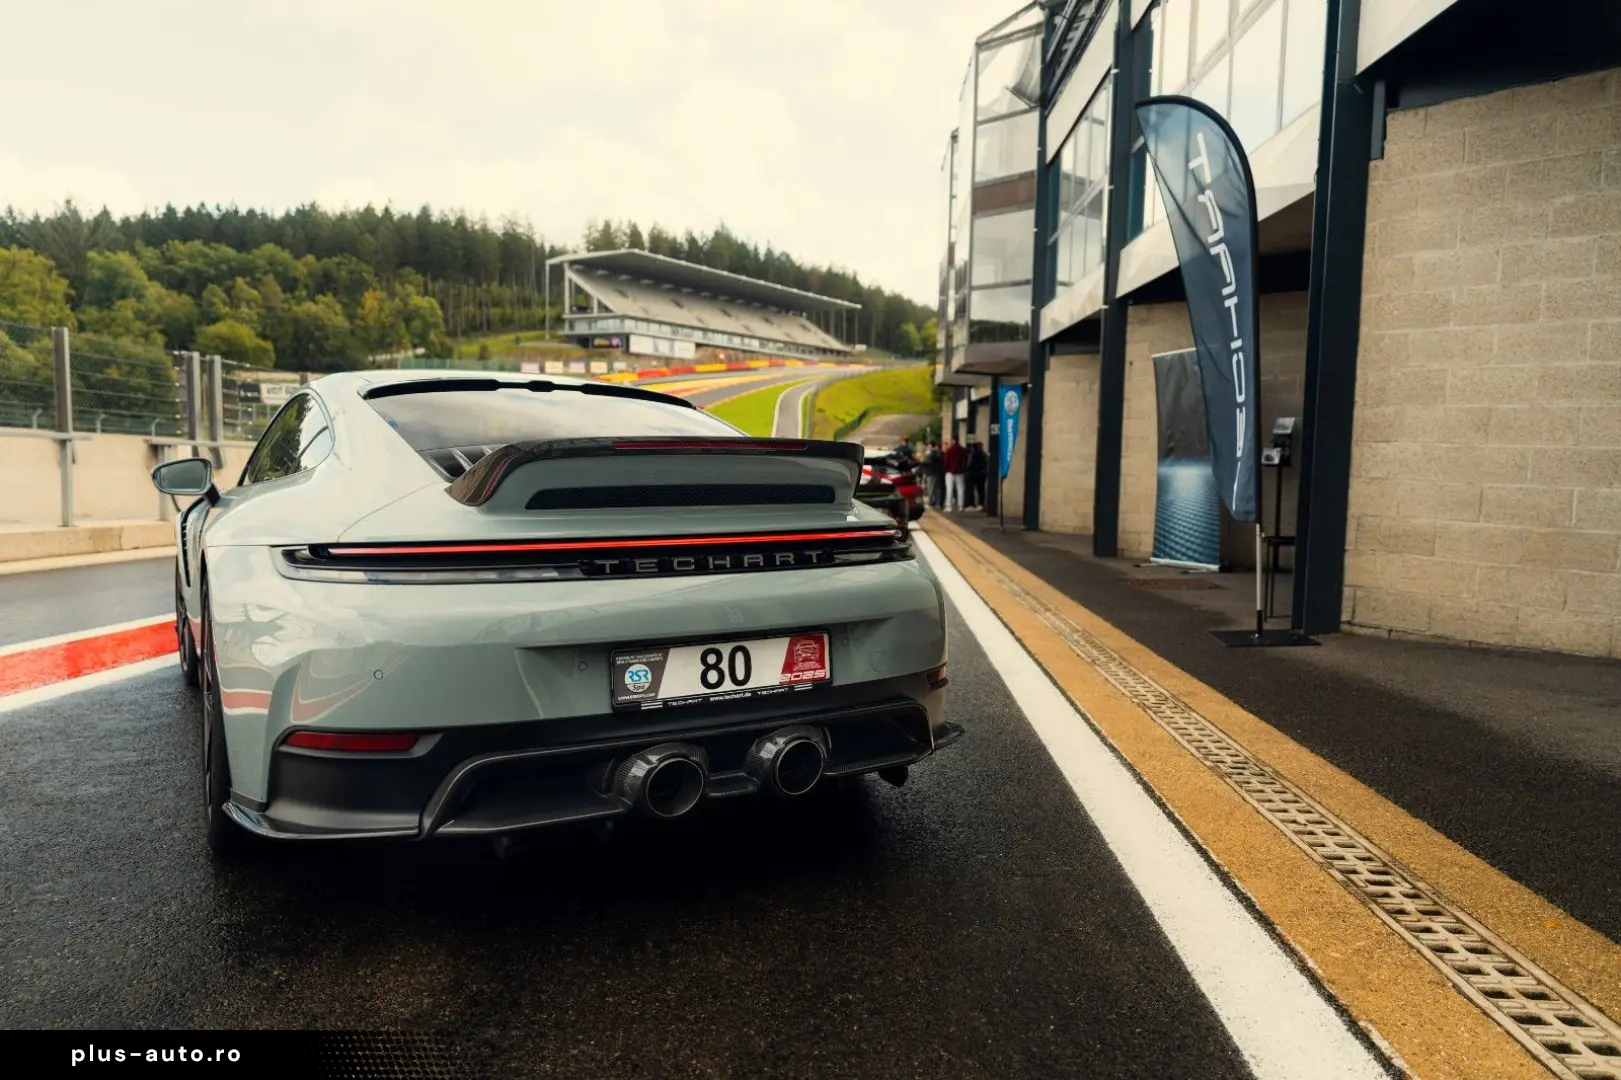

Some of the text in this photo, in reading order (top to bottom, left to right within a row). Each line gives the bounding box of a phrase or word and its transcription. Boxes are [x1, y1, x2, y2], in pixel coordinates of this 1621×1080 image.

[596, 551, 822, 574] TECHART
[627, 669, 649, 682] RSR
[700, 645, 752, 690] 80
[780, 669, 826, 682] 2025
[668, 698, 702, 706] TECHART
[757, 687, 789, 696] TECHART
